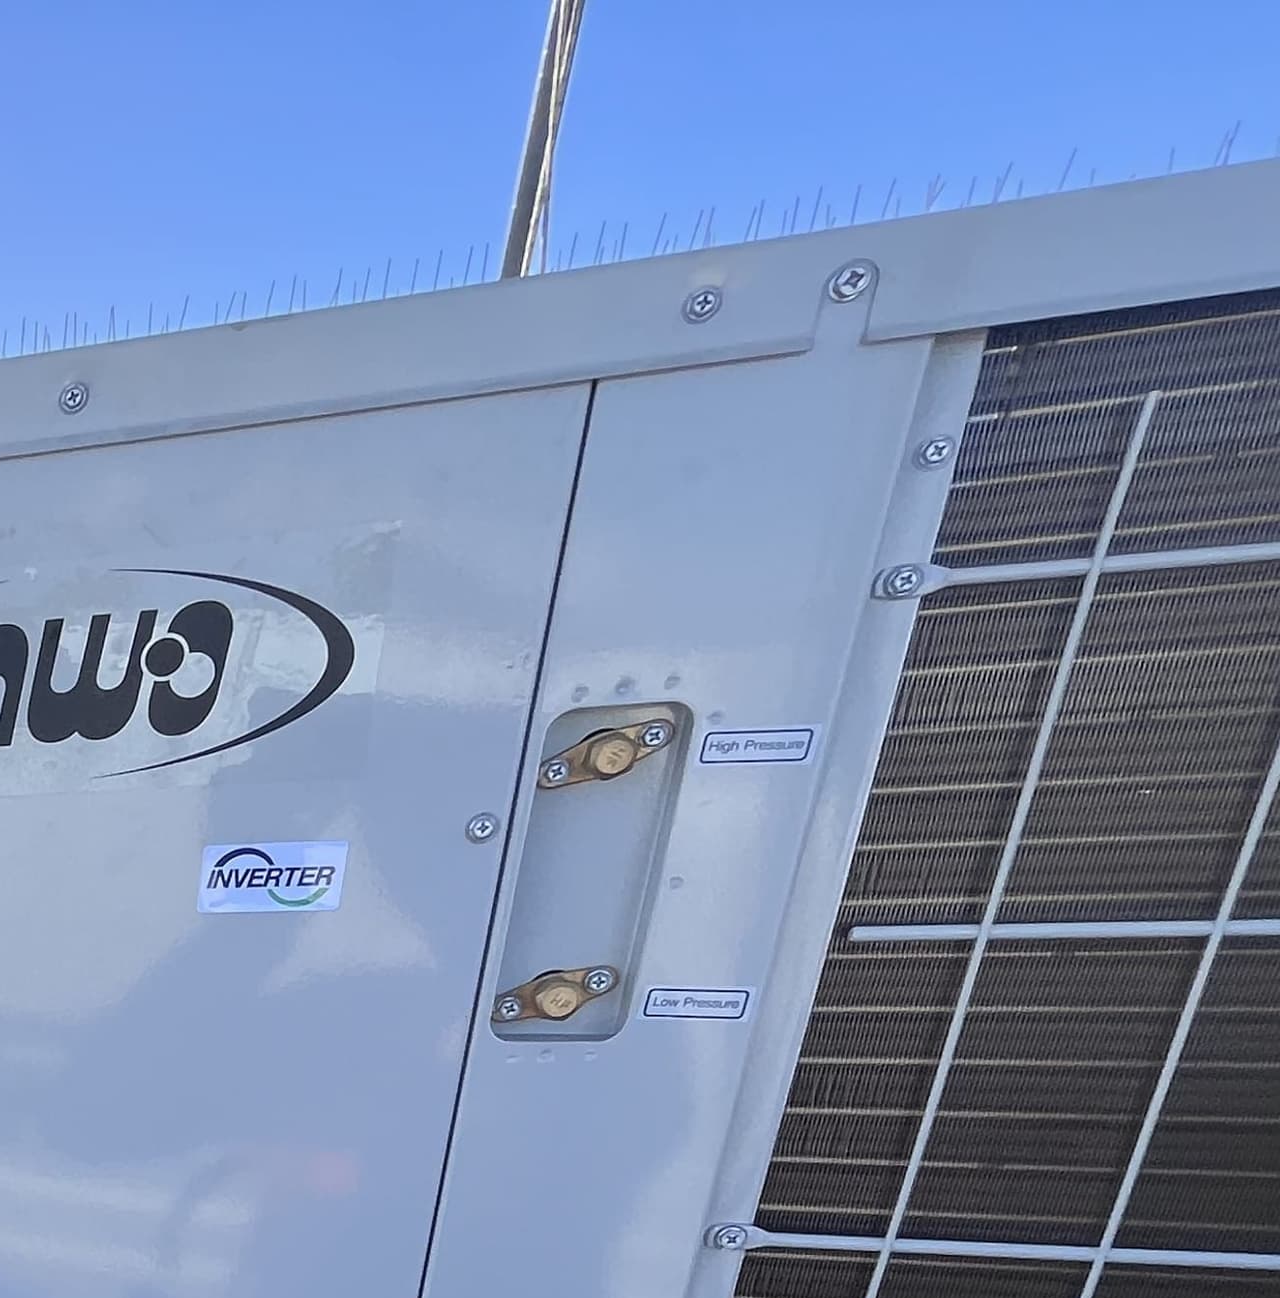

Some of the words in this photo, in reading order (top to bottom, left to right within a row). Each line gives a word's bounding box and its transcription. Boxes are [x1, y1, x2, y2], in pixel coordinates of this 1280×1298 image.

[708, 739, 739, 753] High
[744, 739, 805, 751] Pressure
[206, 865, 336, 889] INVERTER
[652, 997, 679, 1008] Low
[683, 997, 740, 1009] Pressure
